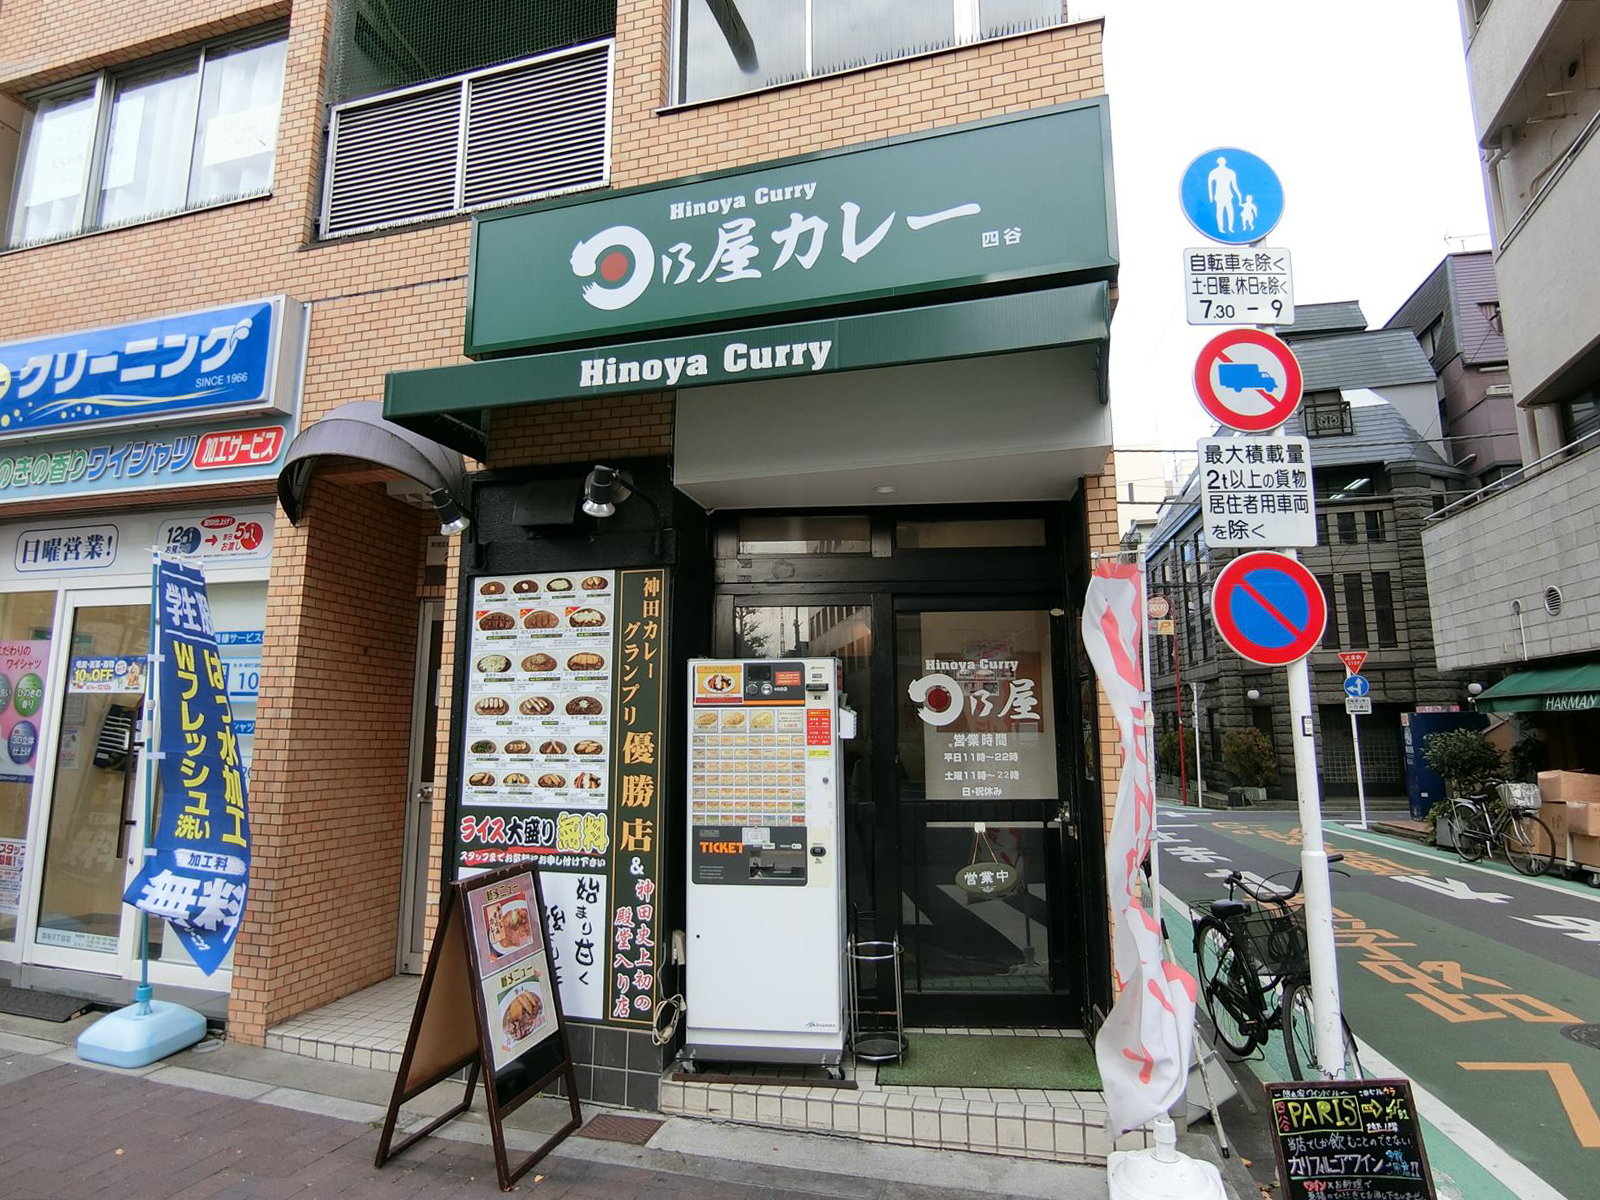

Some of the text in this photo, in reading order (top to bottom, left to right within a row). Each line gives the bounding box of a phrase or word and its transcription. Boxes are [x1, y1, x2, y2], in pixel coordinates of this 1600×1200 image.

[670, 182, 817, 220] Hinoya Curry
[981, 227, 1022, 248] 四谷
[1191, 254, 1285, 272] 自転車を除く
[1271, 299, 1283, 318] 9
[18, 318, 253, 399] クリーニング
[579, 340, 832, 387] Hinoya Curry
[195, 372, 248, 389] SINCE 1966
[1205, 444, 1305, 464] 最大積載量
[1206, 469, 1307, 489] 2t以上の貨物
[1209, 494, 1309, 515] 居住者用車両
[1211, 519, 1266, 540] を除く
[642, 576, 661, 679] 神田カレー
[621, 621, 642, 727] グランプリ
[925, 658, 1018, 672] Hinoya Curry
[953, 733, 1008, 748] 営業時間
[620, 731, 656, 852] 優勝店
[699, 842, 745, 854] TICKET
[187, 853, 229, 871] 加工料
[629, 857, 644, 875] &
[963, 869, 1009, 885] 営業中
[575, 876, 600, 985] 始まり甘く
[634, 878, 655, 1011] 神田史上初の
[613, 905, 634, 1018] 殿堂入り店
[1287, 1099, 1358, 1128] PARIS
